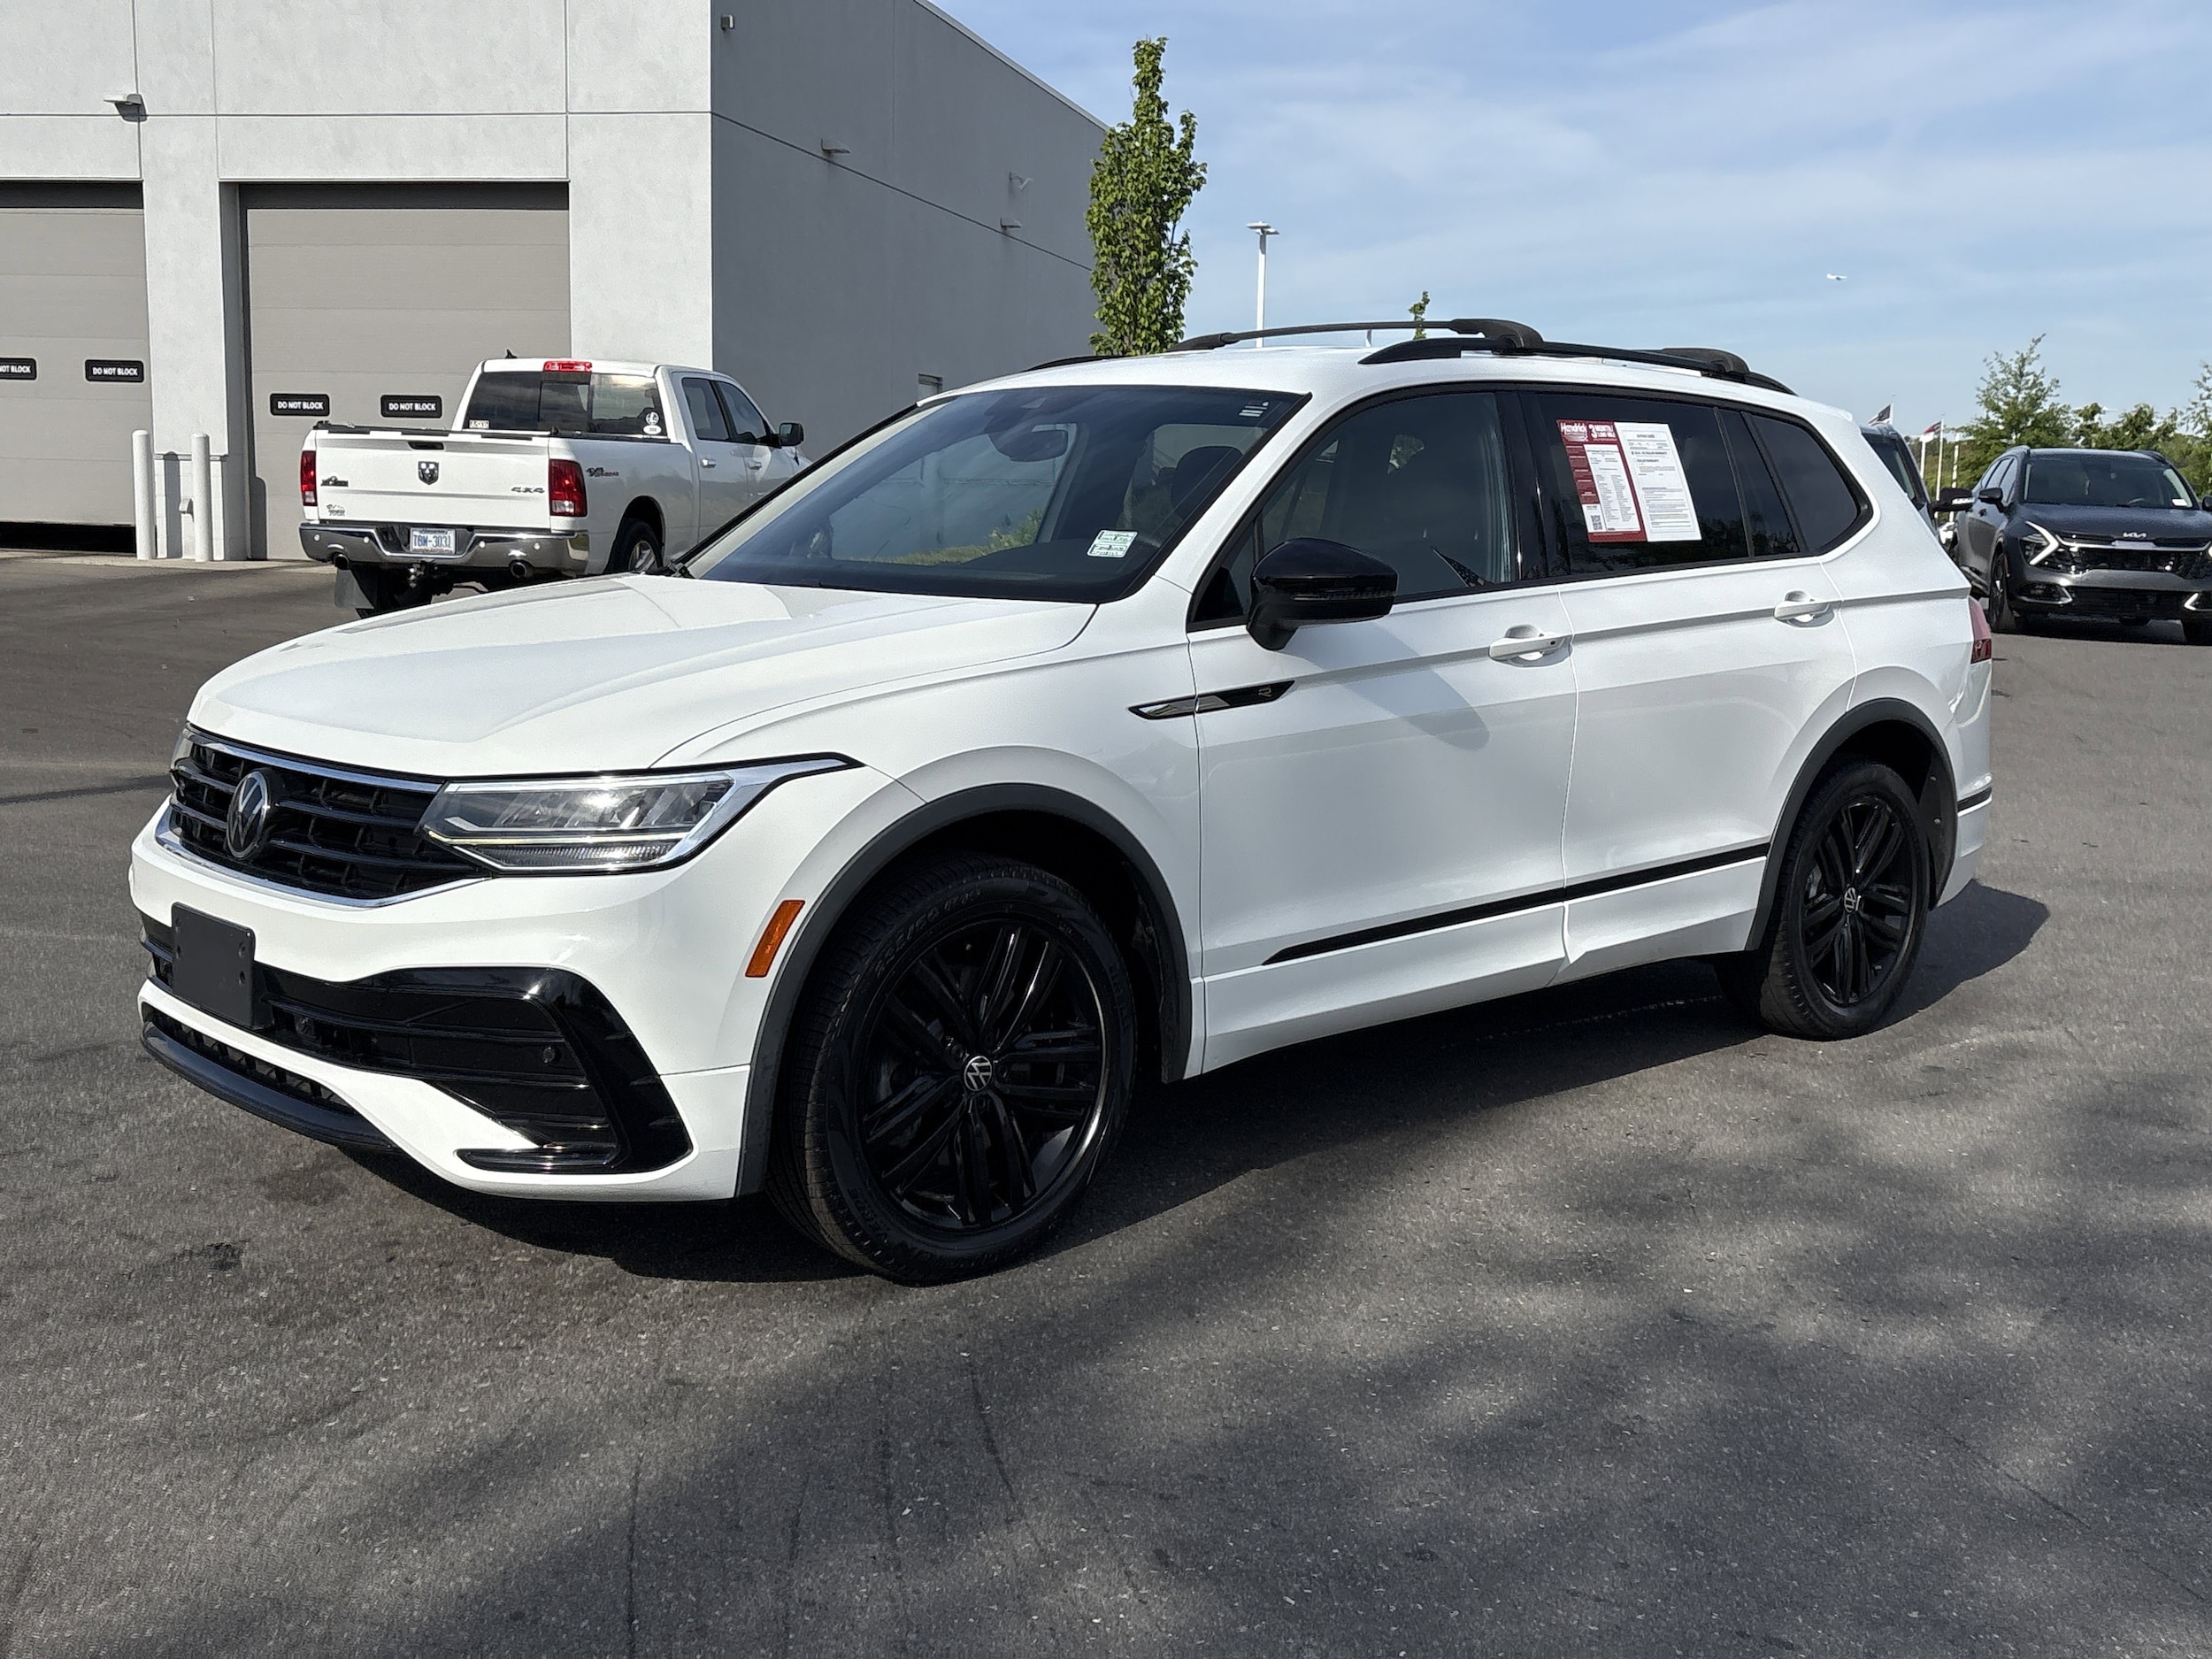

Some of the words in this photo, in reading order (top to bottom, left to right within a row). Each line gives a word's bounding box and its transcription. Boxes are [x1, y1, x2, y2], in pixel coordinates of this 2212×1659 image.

[92, 366, 103, 375] DO
[117, 367, 138, 376] BLOCK
[288, 401, 302, 410] NOT
[302, 401, 324, 410] BLOCK
[388, 402, 399, 411] DO
[399, 403, 413, 411] NOT
[414, 403, 436, 411] BLOCK
